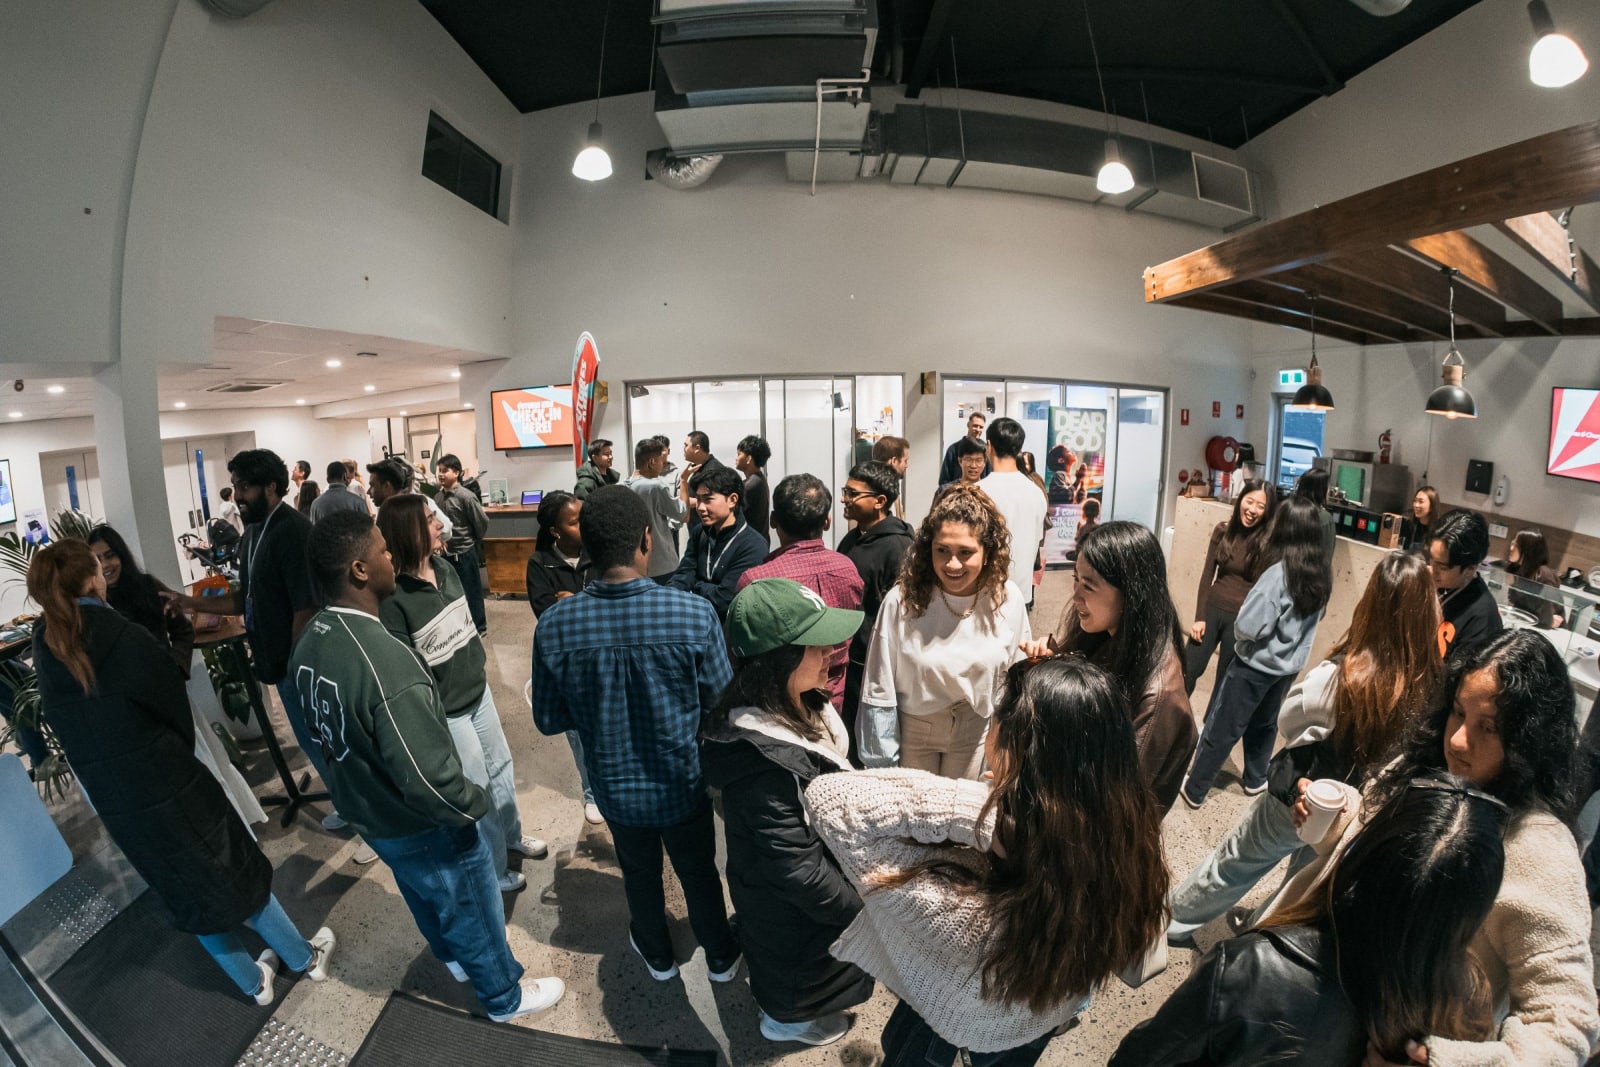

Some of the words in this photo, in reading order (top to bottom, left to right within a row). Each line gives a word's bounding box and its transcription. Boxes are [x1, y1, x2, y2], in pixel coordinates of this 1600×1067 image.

[511, 407, 562, 422] CHECK-IN
[1055, 410, 1105, 432] DEAR
[1056, 431, 1102, 451] GOD
[1055, 506, 1060, 516] I
[1050, 516, 1065, 528] alk
